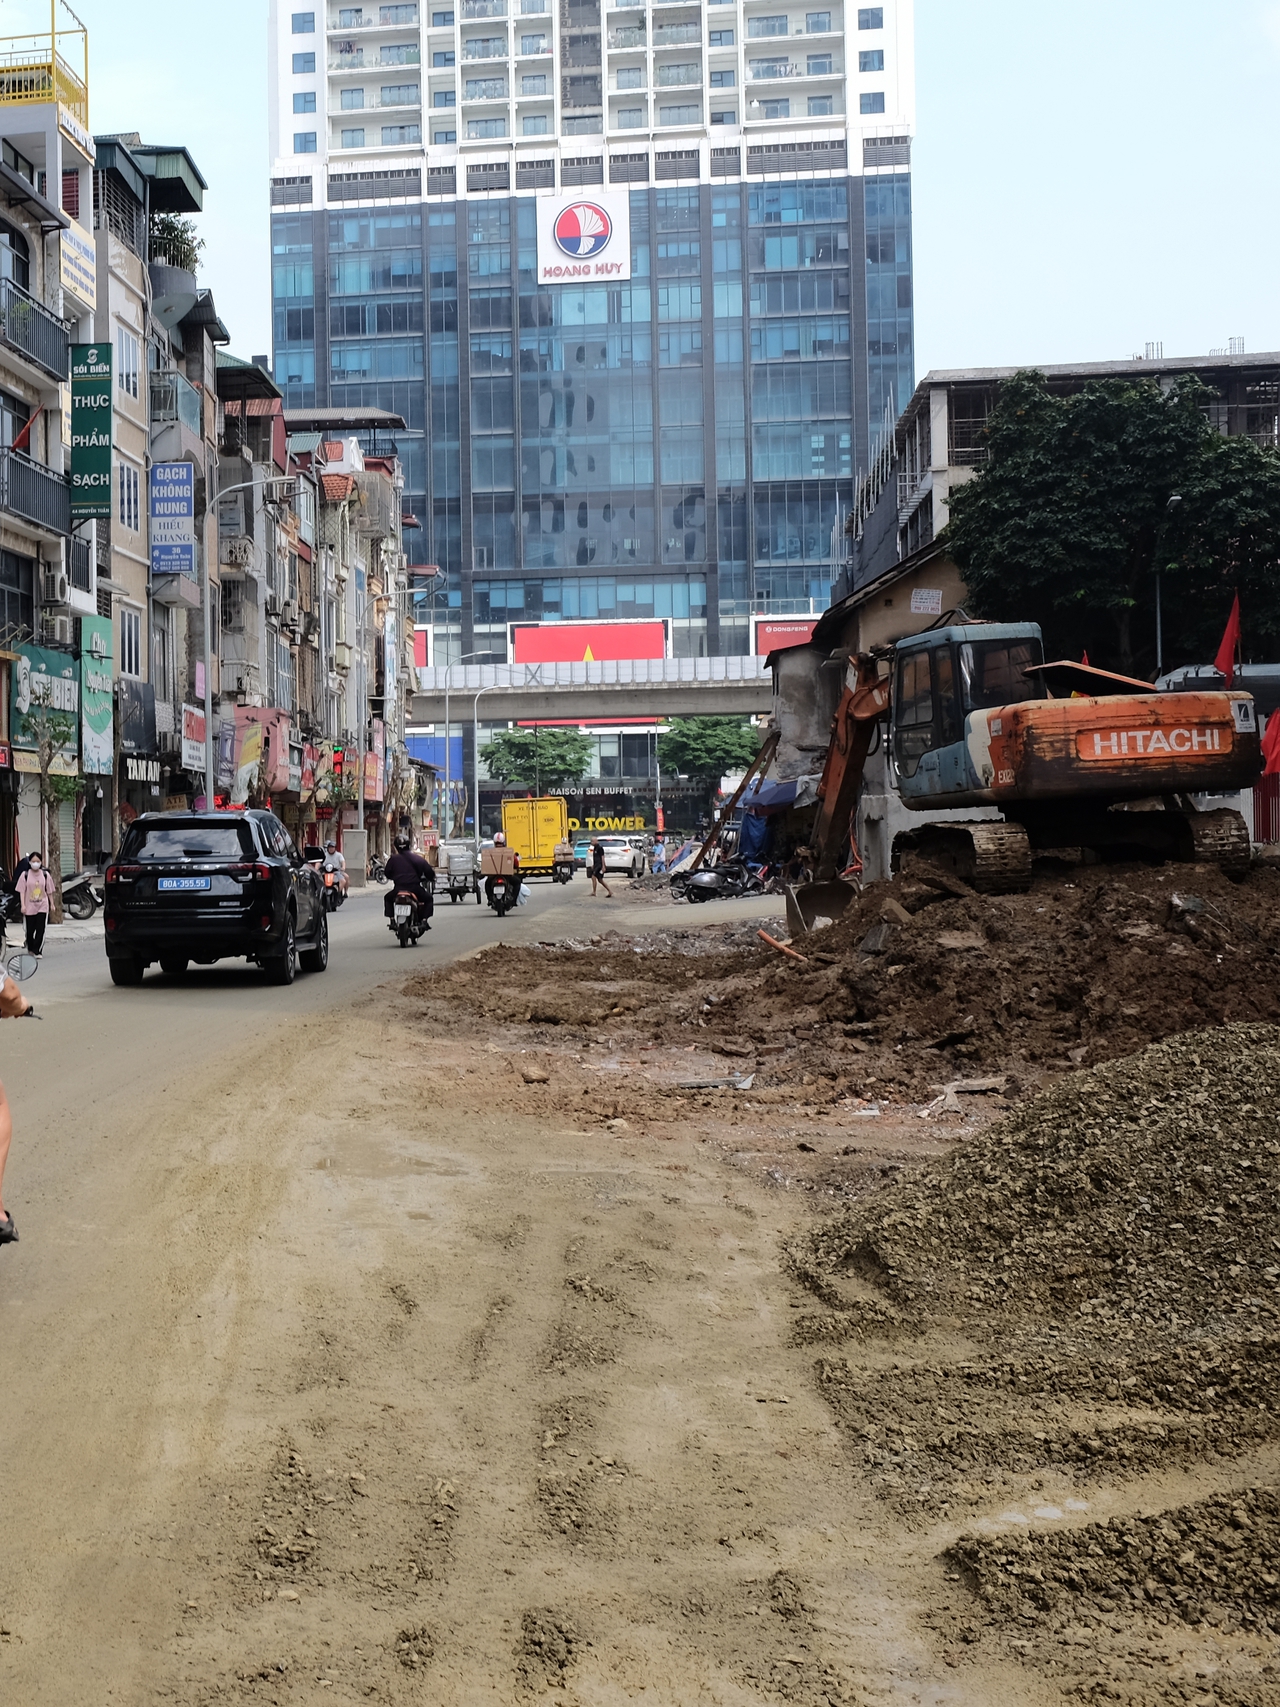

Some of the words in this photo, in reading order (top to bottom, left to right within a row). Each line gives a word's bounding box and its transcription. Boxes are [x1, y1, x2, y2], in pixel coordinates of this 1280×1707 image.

[543, 264, 591, 278] HOANG
[595, 263, 623, 275] HUY
[73, 363, 87, 374] SÓI
[90, 362, 110, 373] BIỂN
[73, 393, 109, 411] THỰC
[72, 428, 109, 447] PHẨM
[73, 473, 109, 489] SẠCH
[156, 467, 186, 482] GẠCH
[152, 483, 191, 498] KHÔNG
[155, 502, 187, 514] NUNG
[158, 517, 184, 531] HIẾU
[153, 533, 190, 542] KHANG
[1093, 728, 1220, 756] HITACHI
[148, 761, 160, 782] AN
[548, 787, 583, 796] MAISON
[586, 787, 602, 795] SEN
[585, 816, 646, 831] TOWER
